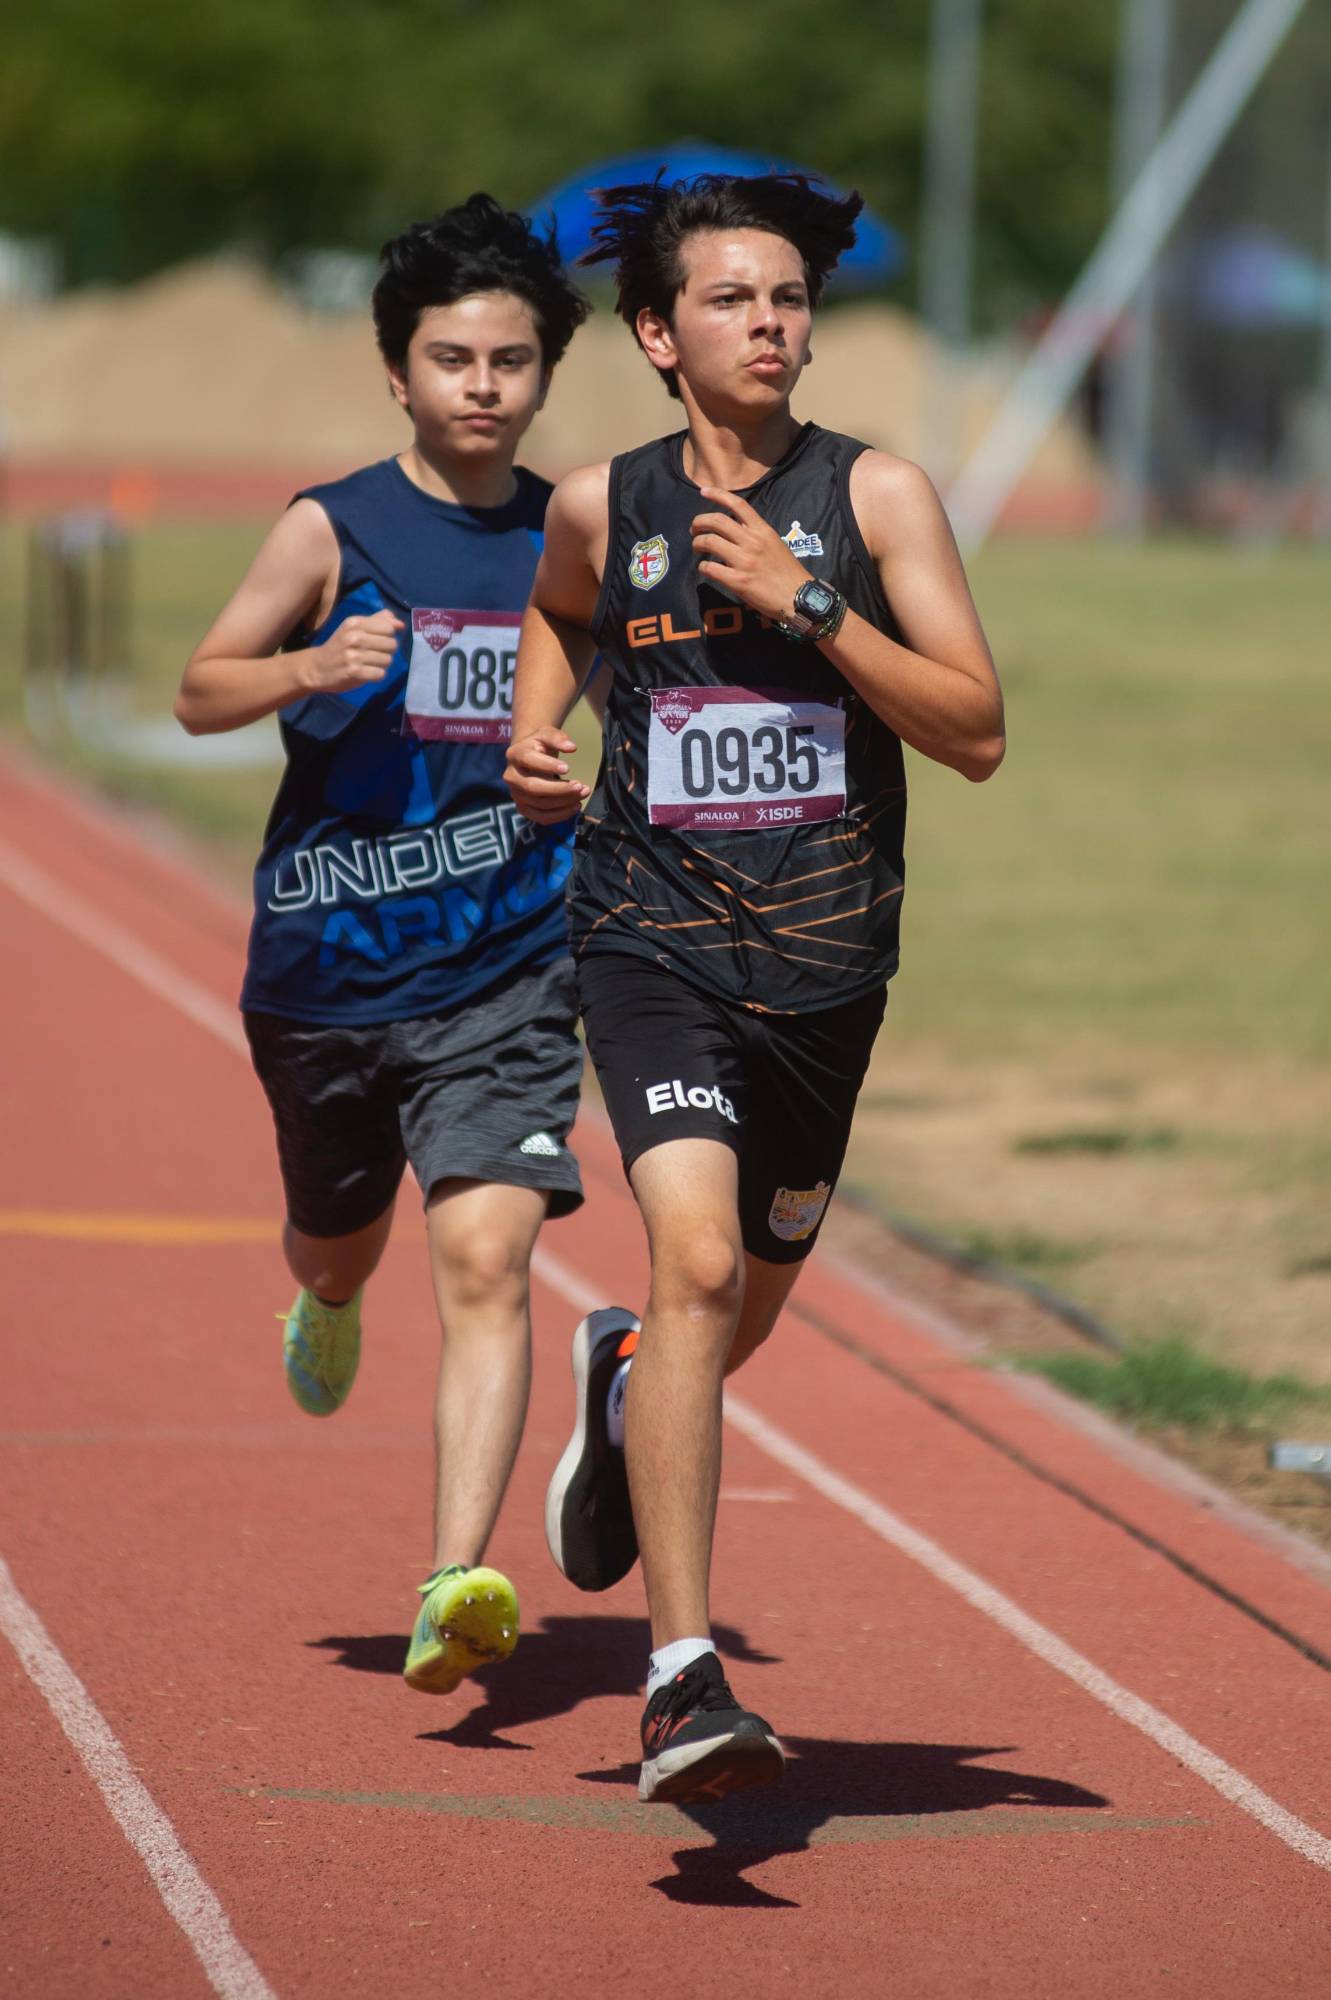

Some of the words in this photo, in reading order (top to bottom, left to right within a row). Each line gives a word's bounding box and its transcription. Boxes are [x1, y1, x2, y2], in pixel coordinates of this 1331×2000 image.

[788, 536, 817, 548] MDEE
[626, 607, 745, 648] ELO
[438, 646, 518, 712] 085
[444, 724, 484, 735] SINALOA
[680, 726, 820, 798] 0935
[694, 811, 740, 821] SINALOA
[769, 806, 803, 821] ISDE
[645, 1079, 740, 1124] Elota
[520, 1144, 559, 1157] adidas
